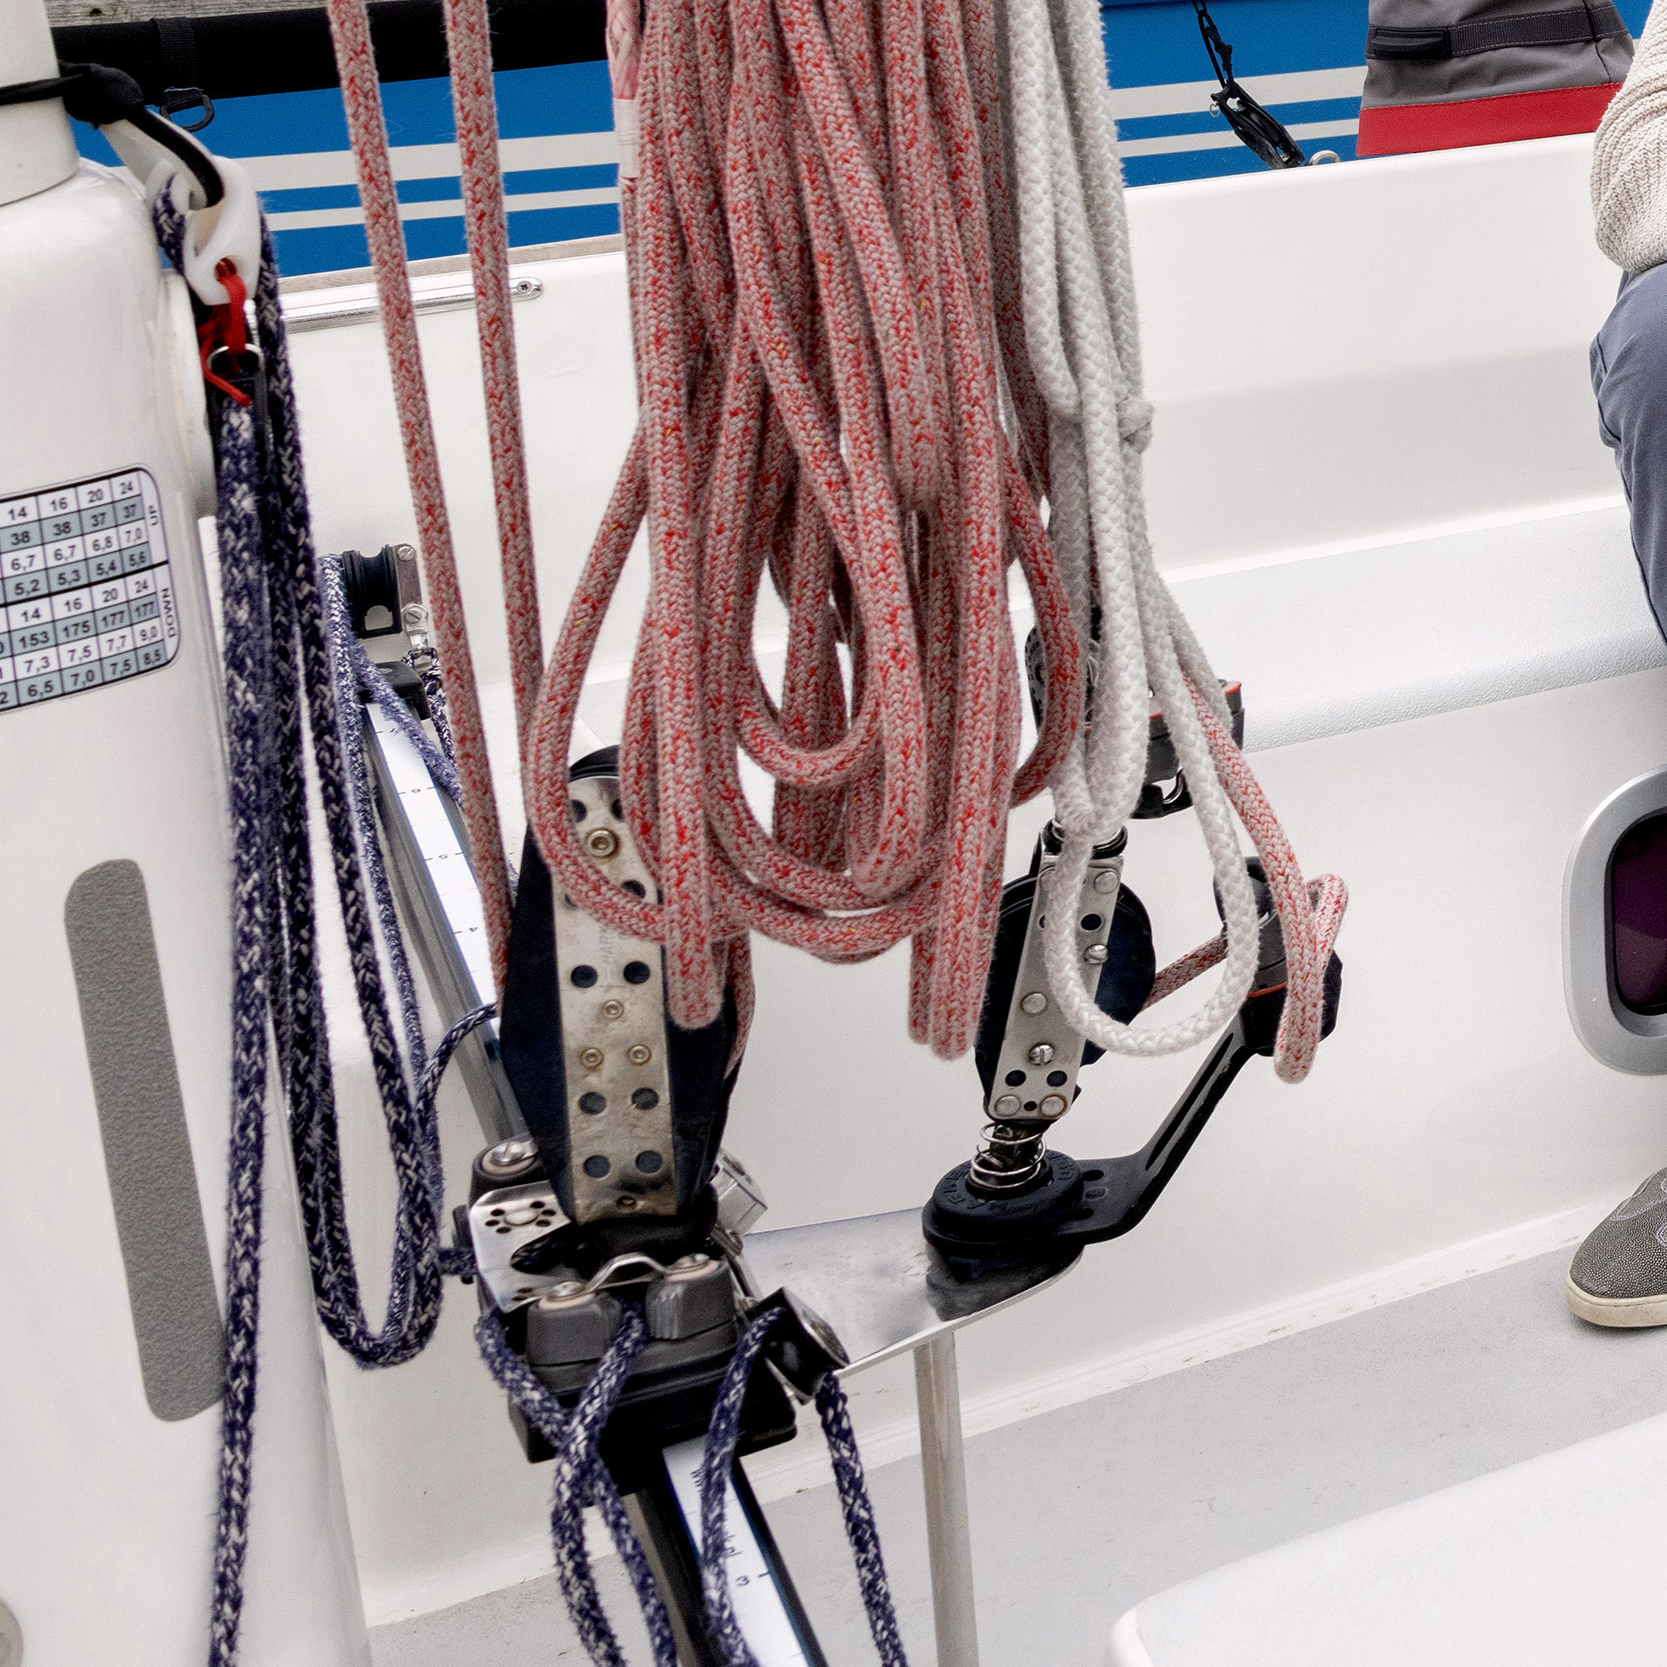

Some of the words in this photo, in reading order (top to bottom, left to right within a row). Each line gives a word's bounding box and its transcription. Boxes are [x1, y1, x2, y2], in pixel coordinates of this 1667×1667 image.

[8, 506, 28, 520] 14
[50, 496, 68, 512] 16
[87, 488, 104, 504] 20
[118, 478, 134, 495] 24
[148, 504, 160, 527] UP
[10, 531, 31, 546] 38
[52, 520, 72, 537] 38
[91, 512, 108, 528] 37
[122, 503, 138, 519] 37
[10, 554, 36, 573] 6,7
[53, 544, 76, 562] 6,7
[91, 535, 113, 553] 6,8
[124, 527, 143, 544] 7,0
[14, 579, 41, 598] 5,2
[56, 569, 82, 587] 5,3
[95, 561, 117, 578] 5,4
[21, 607, 41, 623] 14
[63, 597, 83, 614] 16
[101, 587, 119, 603] 20
[133, 578, 150, 594] 24
[18, 630, 50, 649] 153
[62, 620, 92, 639] 175
[100, 610, 127, 628] 177
[133, 600, 157, 618] 177
[160, 587, 177, 639] DOWN
[24, 656, 52, 674] 7,3
[68, 645, 92, 663] 7,5
[106, 634, 128, 653] 7,7
[138, 624, 159, 642] 9,0
[27, 681, 55, 700] 6,5
[70, 669, 95, 687] 7,0
[109, 658, 132, 677] 7,5
[143, 649, 163, 666] 8,5
[735, 1574, 750, 1588] 3
